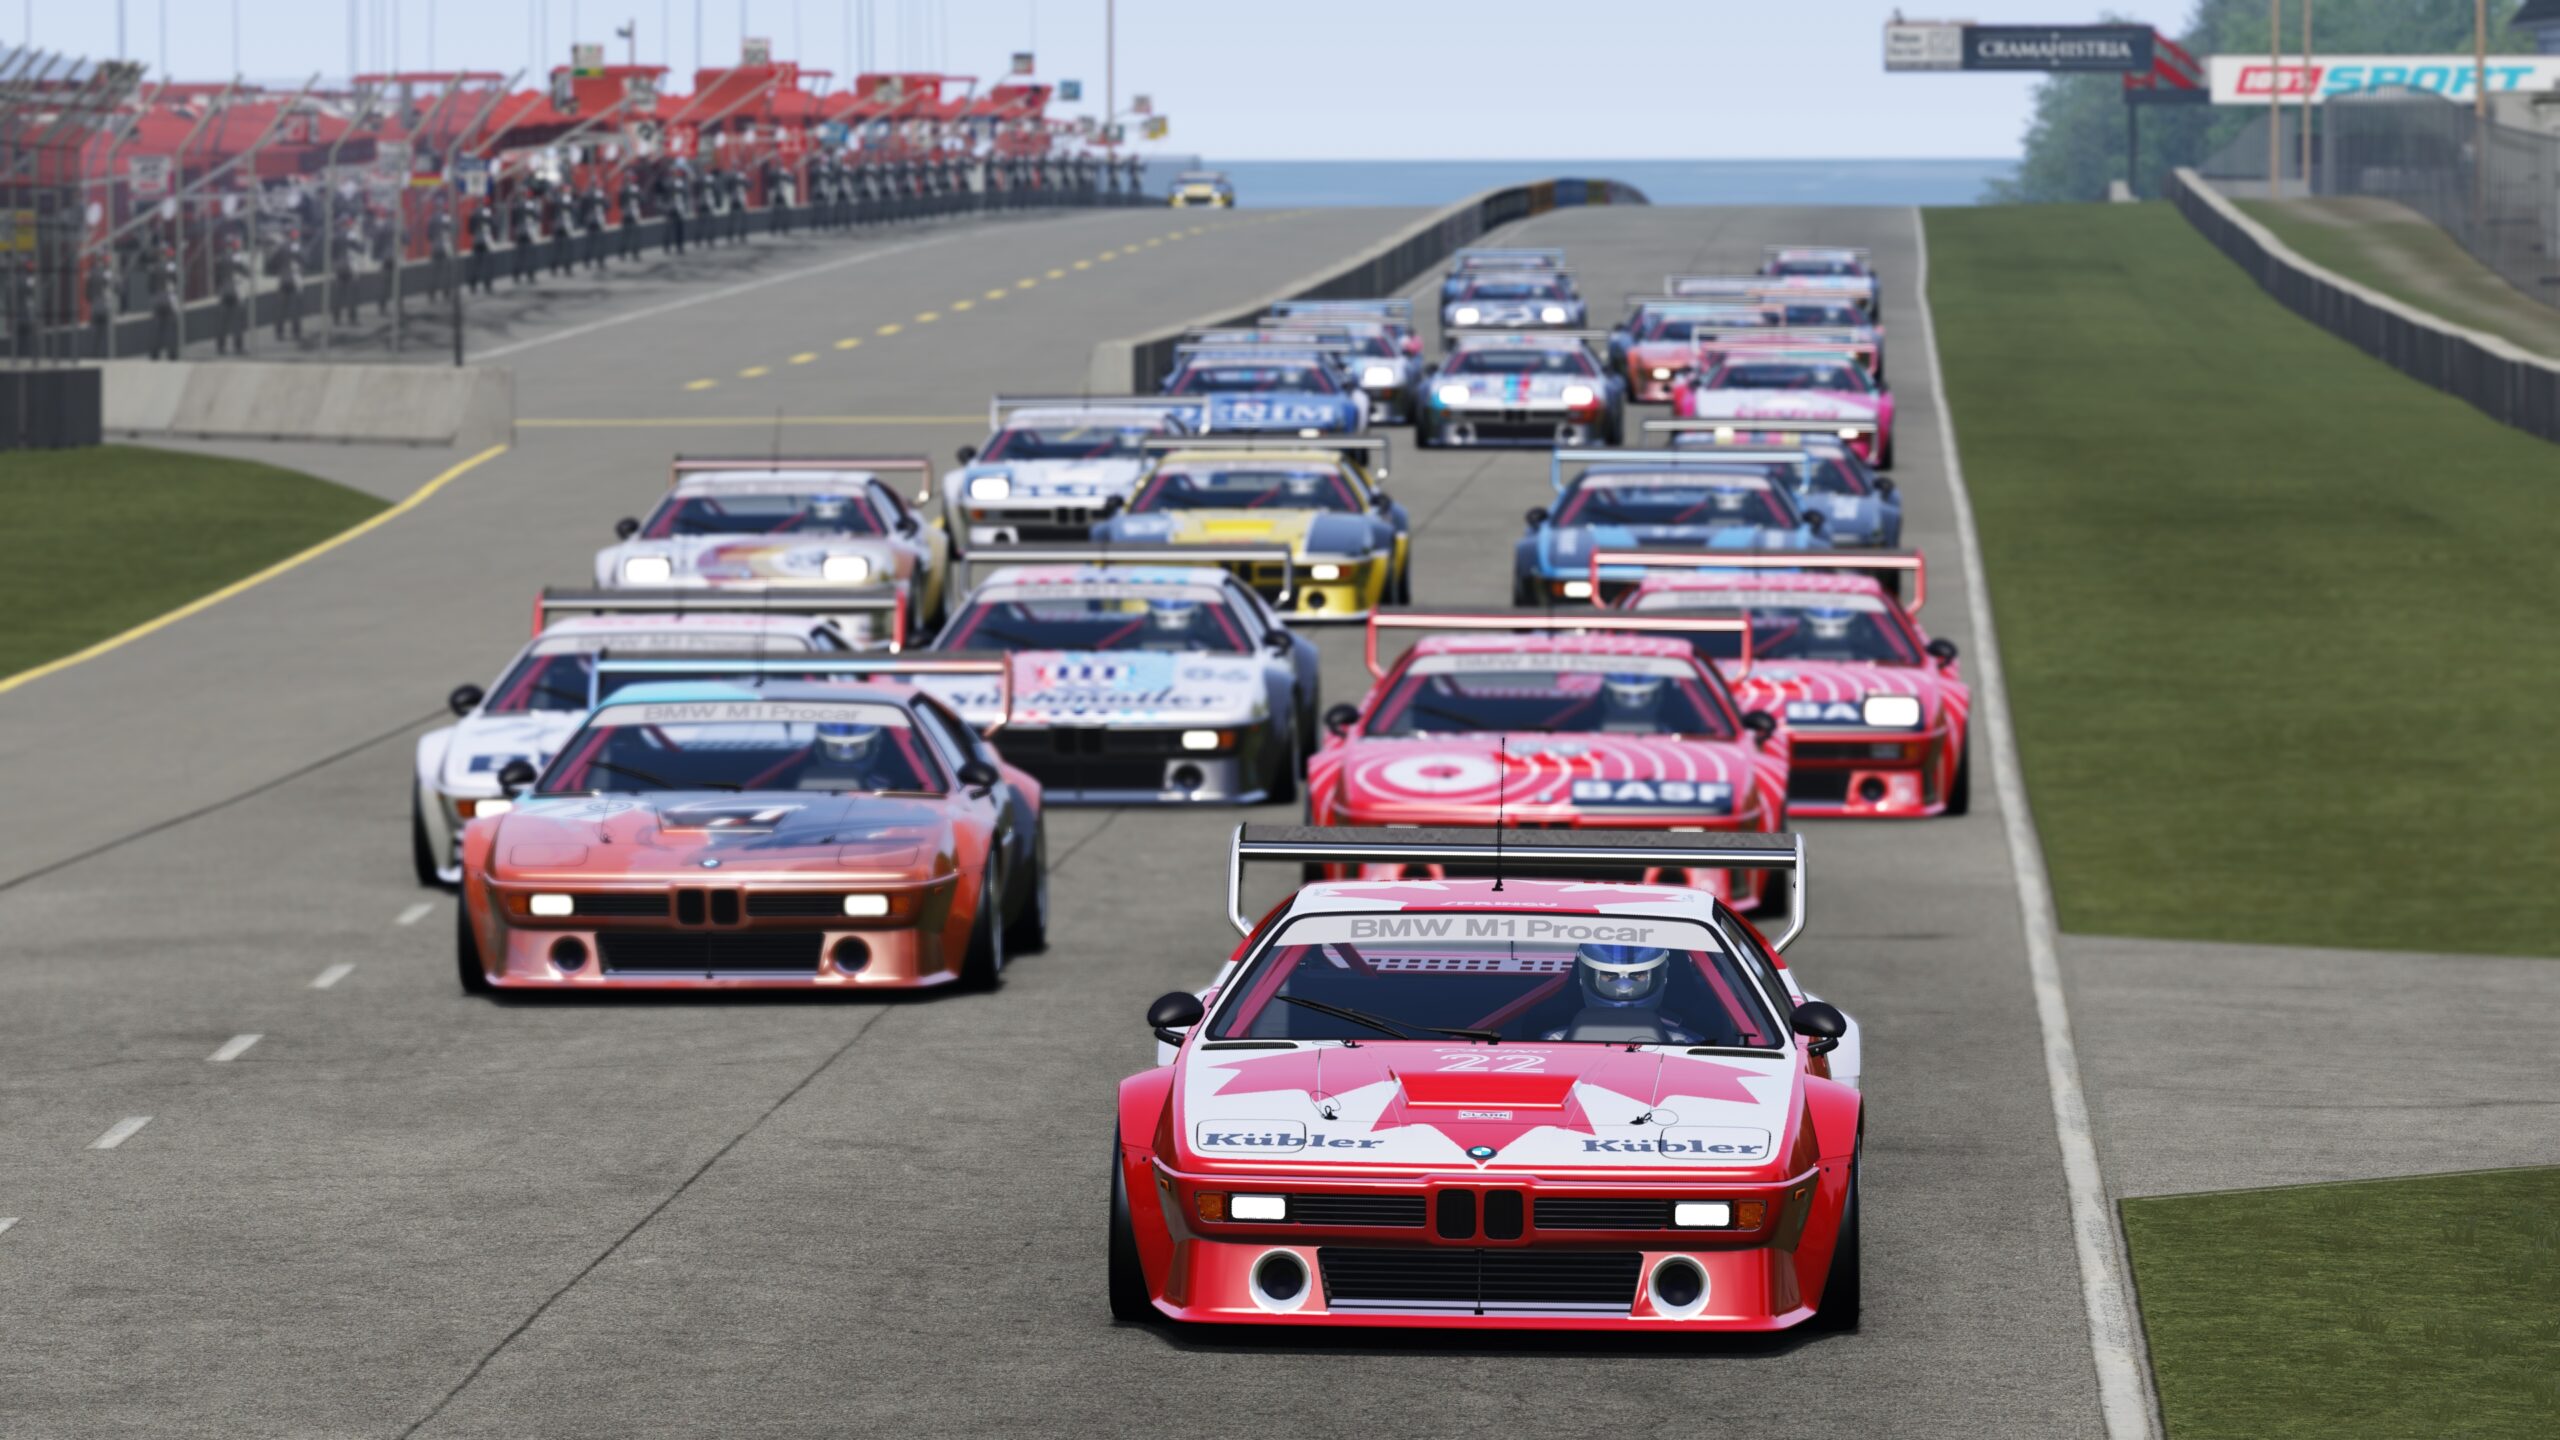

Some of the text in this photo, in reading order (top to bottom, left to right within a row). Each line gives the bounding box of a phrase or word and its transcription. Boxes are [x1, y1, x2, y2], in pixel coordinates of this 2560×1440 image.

[2324, 66, 2535, 95] SPORT
[643, 704, 862, 721] BMW M1 Procar
[1573, 781, 1732, 802] BASF
[1350, 918, 1655, 943] BMW M1 Procar
[1435, 1053, 1547, 1074] 22
[1202, 1133, 1385, 1149] Kübler
[1582, 1139, 1763, 1154] Kübler
